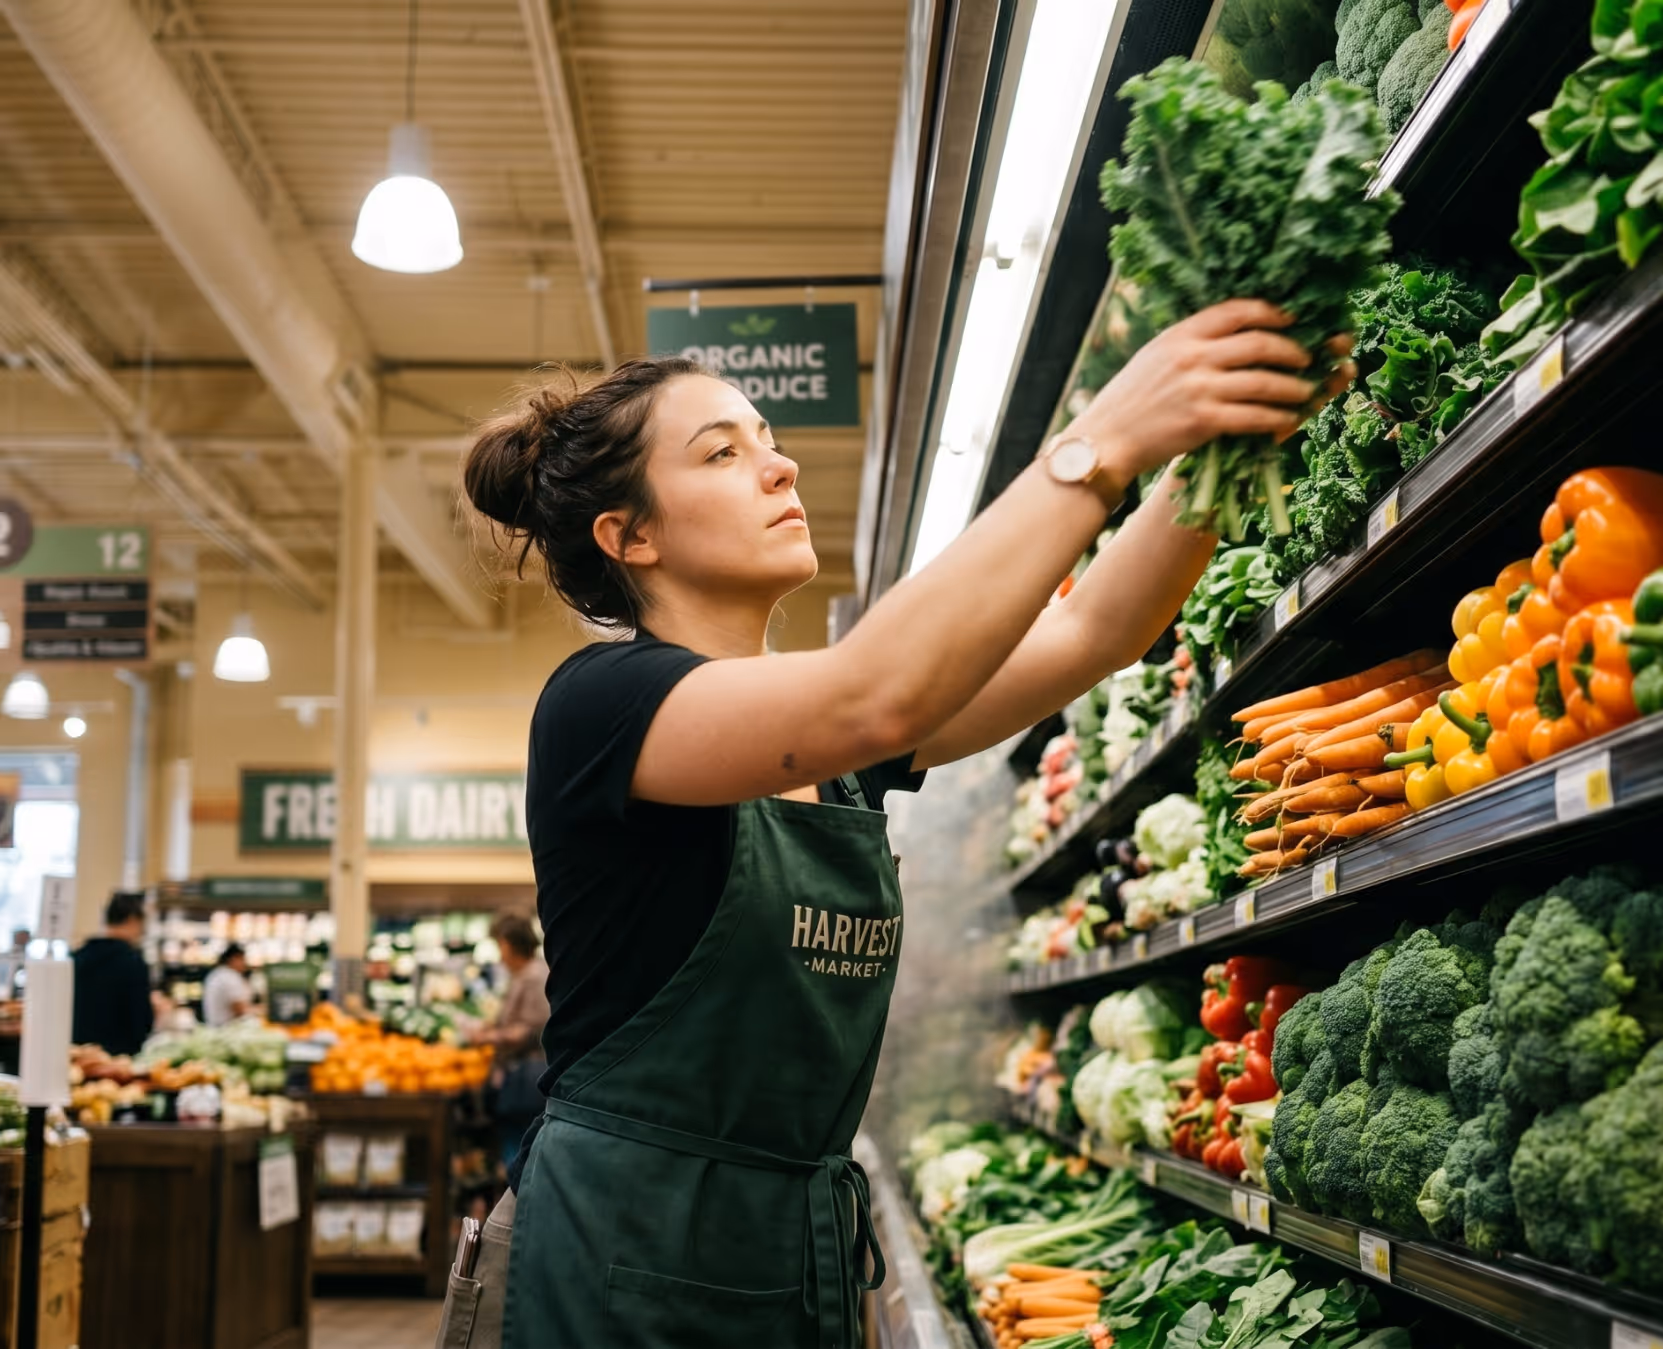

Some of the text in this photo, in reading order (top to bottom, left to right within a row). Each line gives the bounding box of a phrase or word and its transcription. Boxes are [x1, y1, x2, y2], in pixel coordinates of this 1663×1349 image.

[680, 343, 825, 371] ORGANIC
[97, 532, 142, 569] 12
[262, 782, 527, 840] FREH DAIRY
[791, 904, 901, 957] HARVEST
